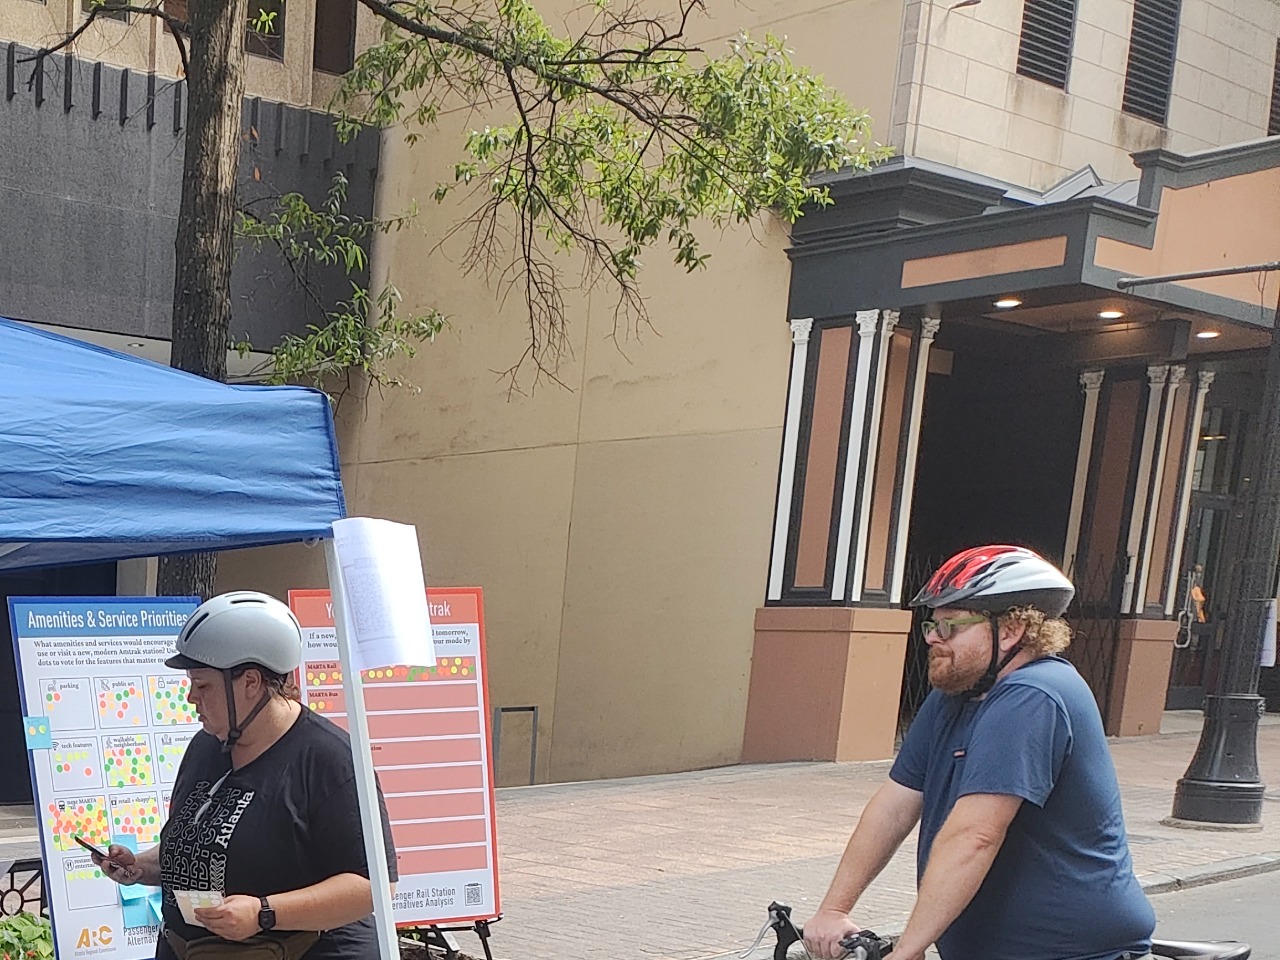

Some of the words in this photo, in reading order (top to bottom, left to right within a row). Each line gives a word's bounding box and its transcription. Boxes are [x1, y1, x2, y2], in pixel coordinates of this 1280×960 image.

[428, 600, 451, 617] trak
[28, 610, 84, 628] Amenities
[87, 611, 96, 628] &
[98, 610, 138, 628] Service
[140, 610, 188, 627] Priorities
[435, 629, 468, 637] tomorrow,
[34, 640, 51, 648] What
[53, 640, 84, 648] amenities
[85, 639, 97, 647] and
[143, 640, 174, 648] encourage
[463, 636, 472, 645] by
[94, 648, 118, 656] modern
[142, 647, 165, 655] station?
[38, 658, 51, 666] dots
[75, 657, 85, 665] for
[85, 657, 96, 665] the
[122, 656, 135, 664] that
[214, 791, 255, 849] Atlanta
[393, 891, 414, 901] enger
[416, 888, 429, 898] Rail
[431, 886, 456, 897] Station
[392, 900, 423, 910] ernatives
[425, 897, 454, 908] Analysis
[123, 924, 159, 936] Passenger
[127, 934, 158, 947] Alternati
